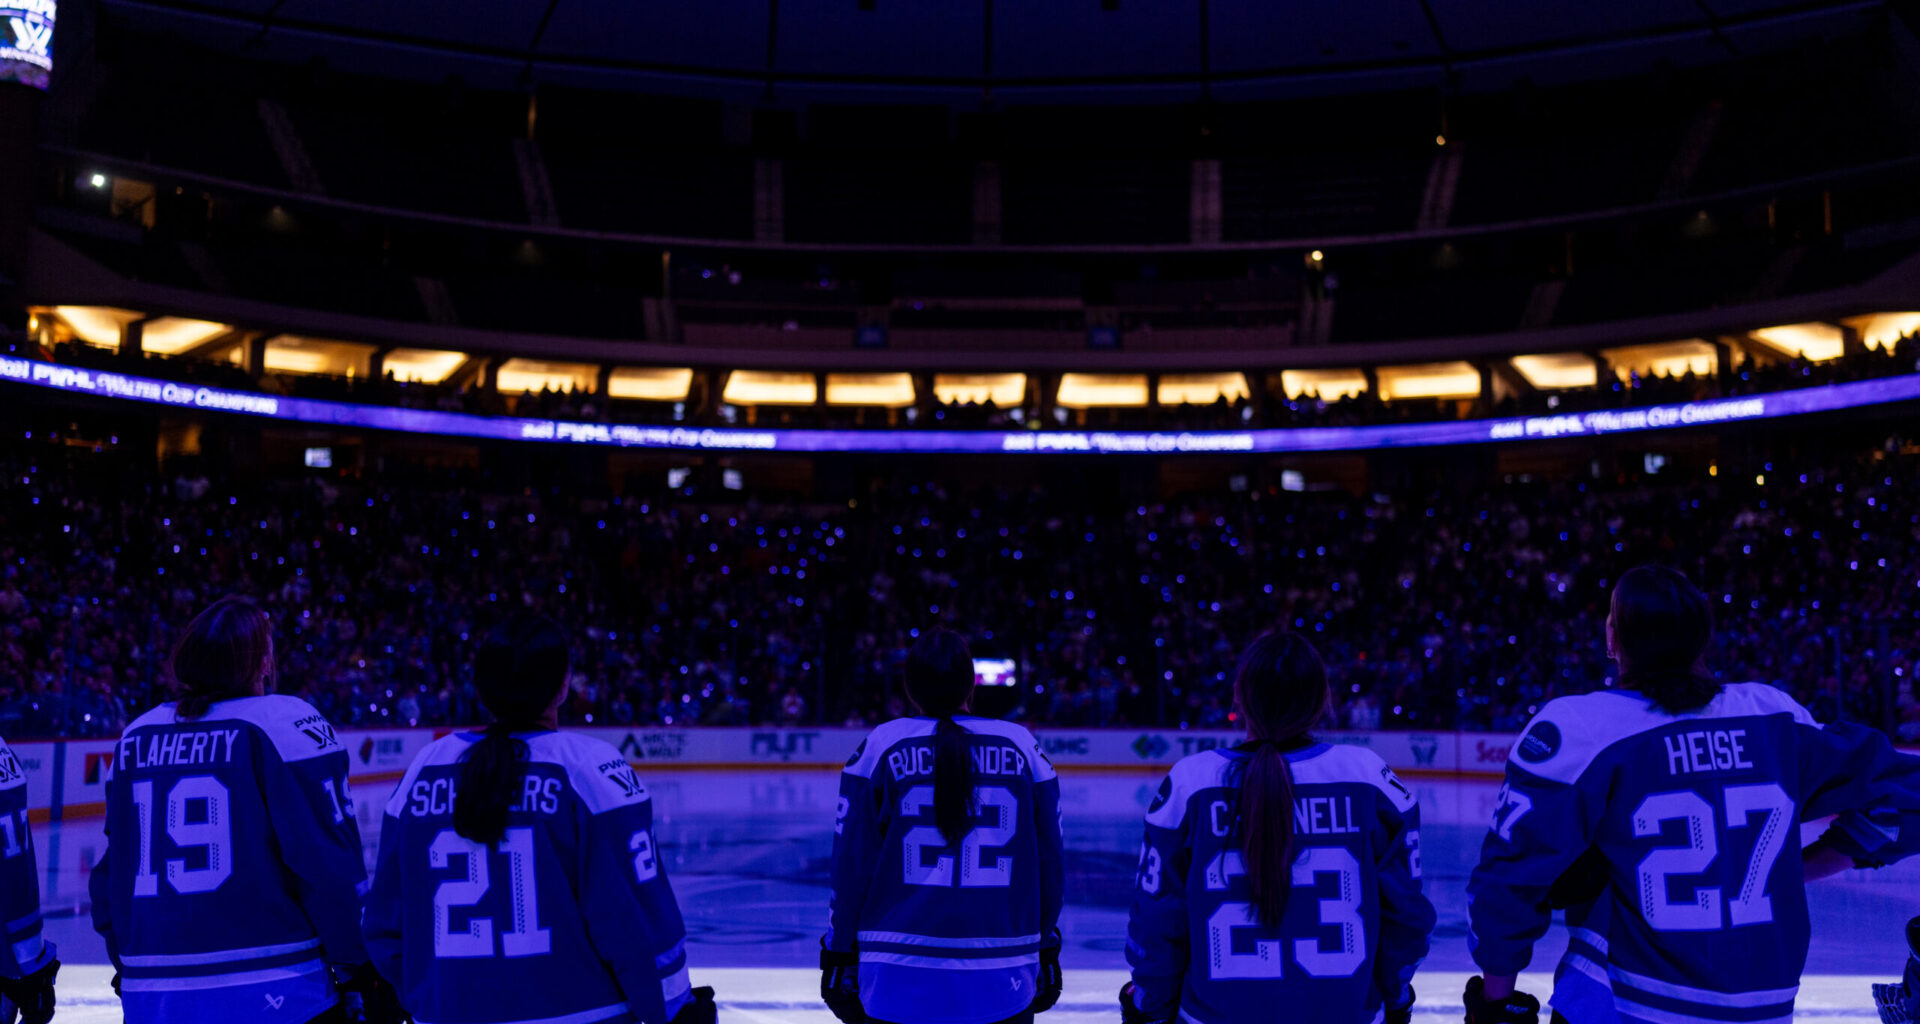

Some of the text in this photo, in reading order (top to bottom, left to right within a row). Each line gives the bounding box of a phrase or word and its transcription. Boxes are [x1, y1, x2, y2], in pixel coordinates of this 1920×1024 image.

[120, 729, 240, 771] FLAHERTY
[888, 745, 1025, 781] BUCNDER
[1664, 729, 1754, 775] HEISE
[132, 775, 234, 897] 19
[900, 786, 1019, 888] 22
[1210, 796, 1360, 838] CNELL
[1632, 783, 1796, 931] 27
[428, 827, 551, 959] 21
[1205, 847, 1367, 980] 23
